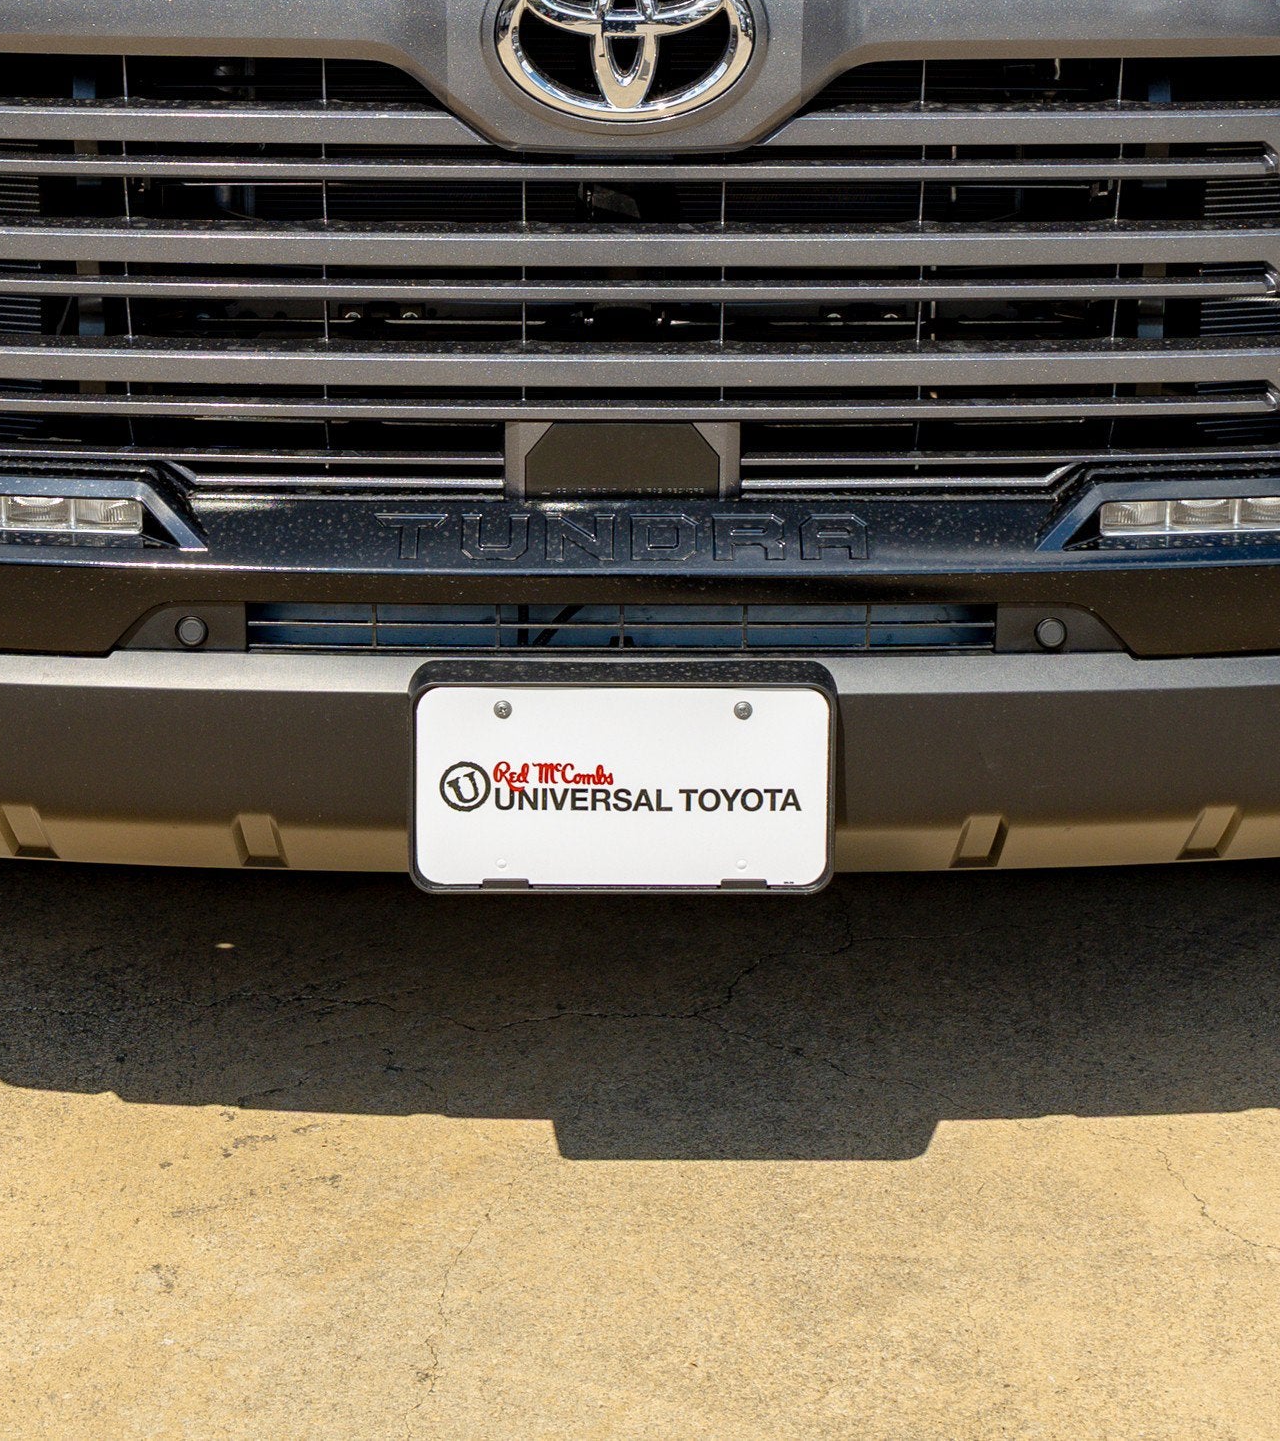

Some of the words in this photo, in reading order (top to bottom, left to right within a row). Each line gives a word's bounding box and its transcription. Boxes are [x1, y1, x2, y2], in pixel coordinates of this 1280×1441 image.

[373, 512, 869, 561] TUNDRA
[493, 761, 529, 792] Red
[533, 761, 614, 786] McCombs
[494, 788, 673, 812] UNIVERSAL
[679, 788, 802, 812] TOYOTA
